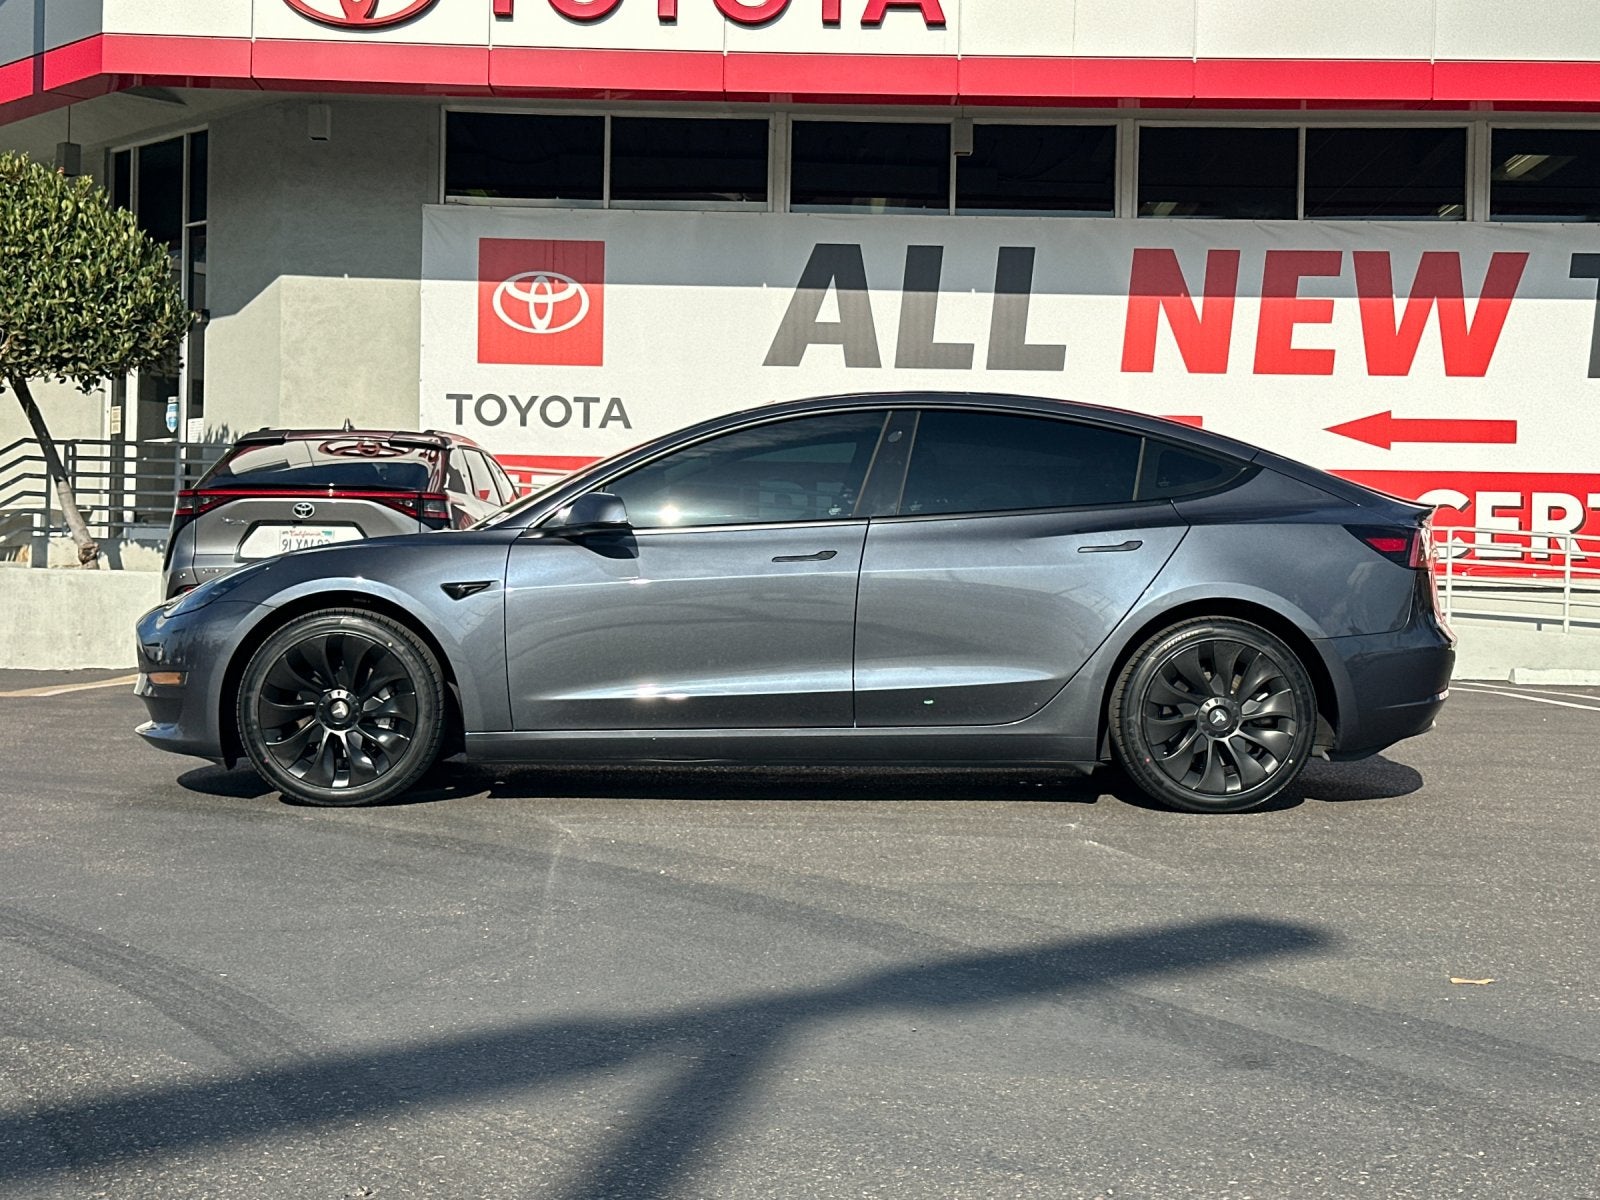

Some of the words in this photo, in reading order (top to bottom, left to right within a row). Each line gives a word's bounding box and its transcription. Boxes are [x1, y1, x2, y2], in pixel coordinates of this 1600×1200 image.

[762, 243, 1066, 371] ALL
[1121, 248, 1530, 377] NEW
[446, 393, 632, 429] TOYOTA
[1416, 488, 1600, 560] CER
